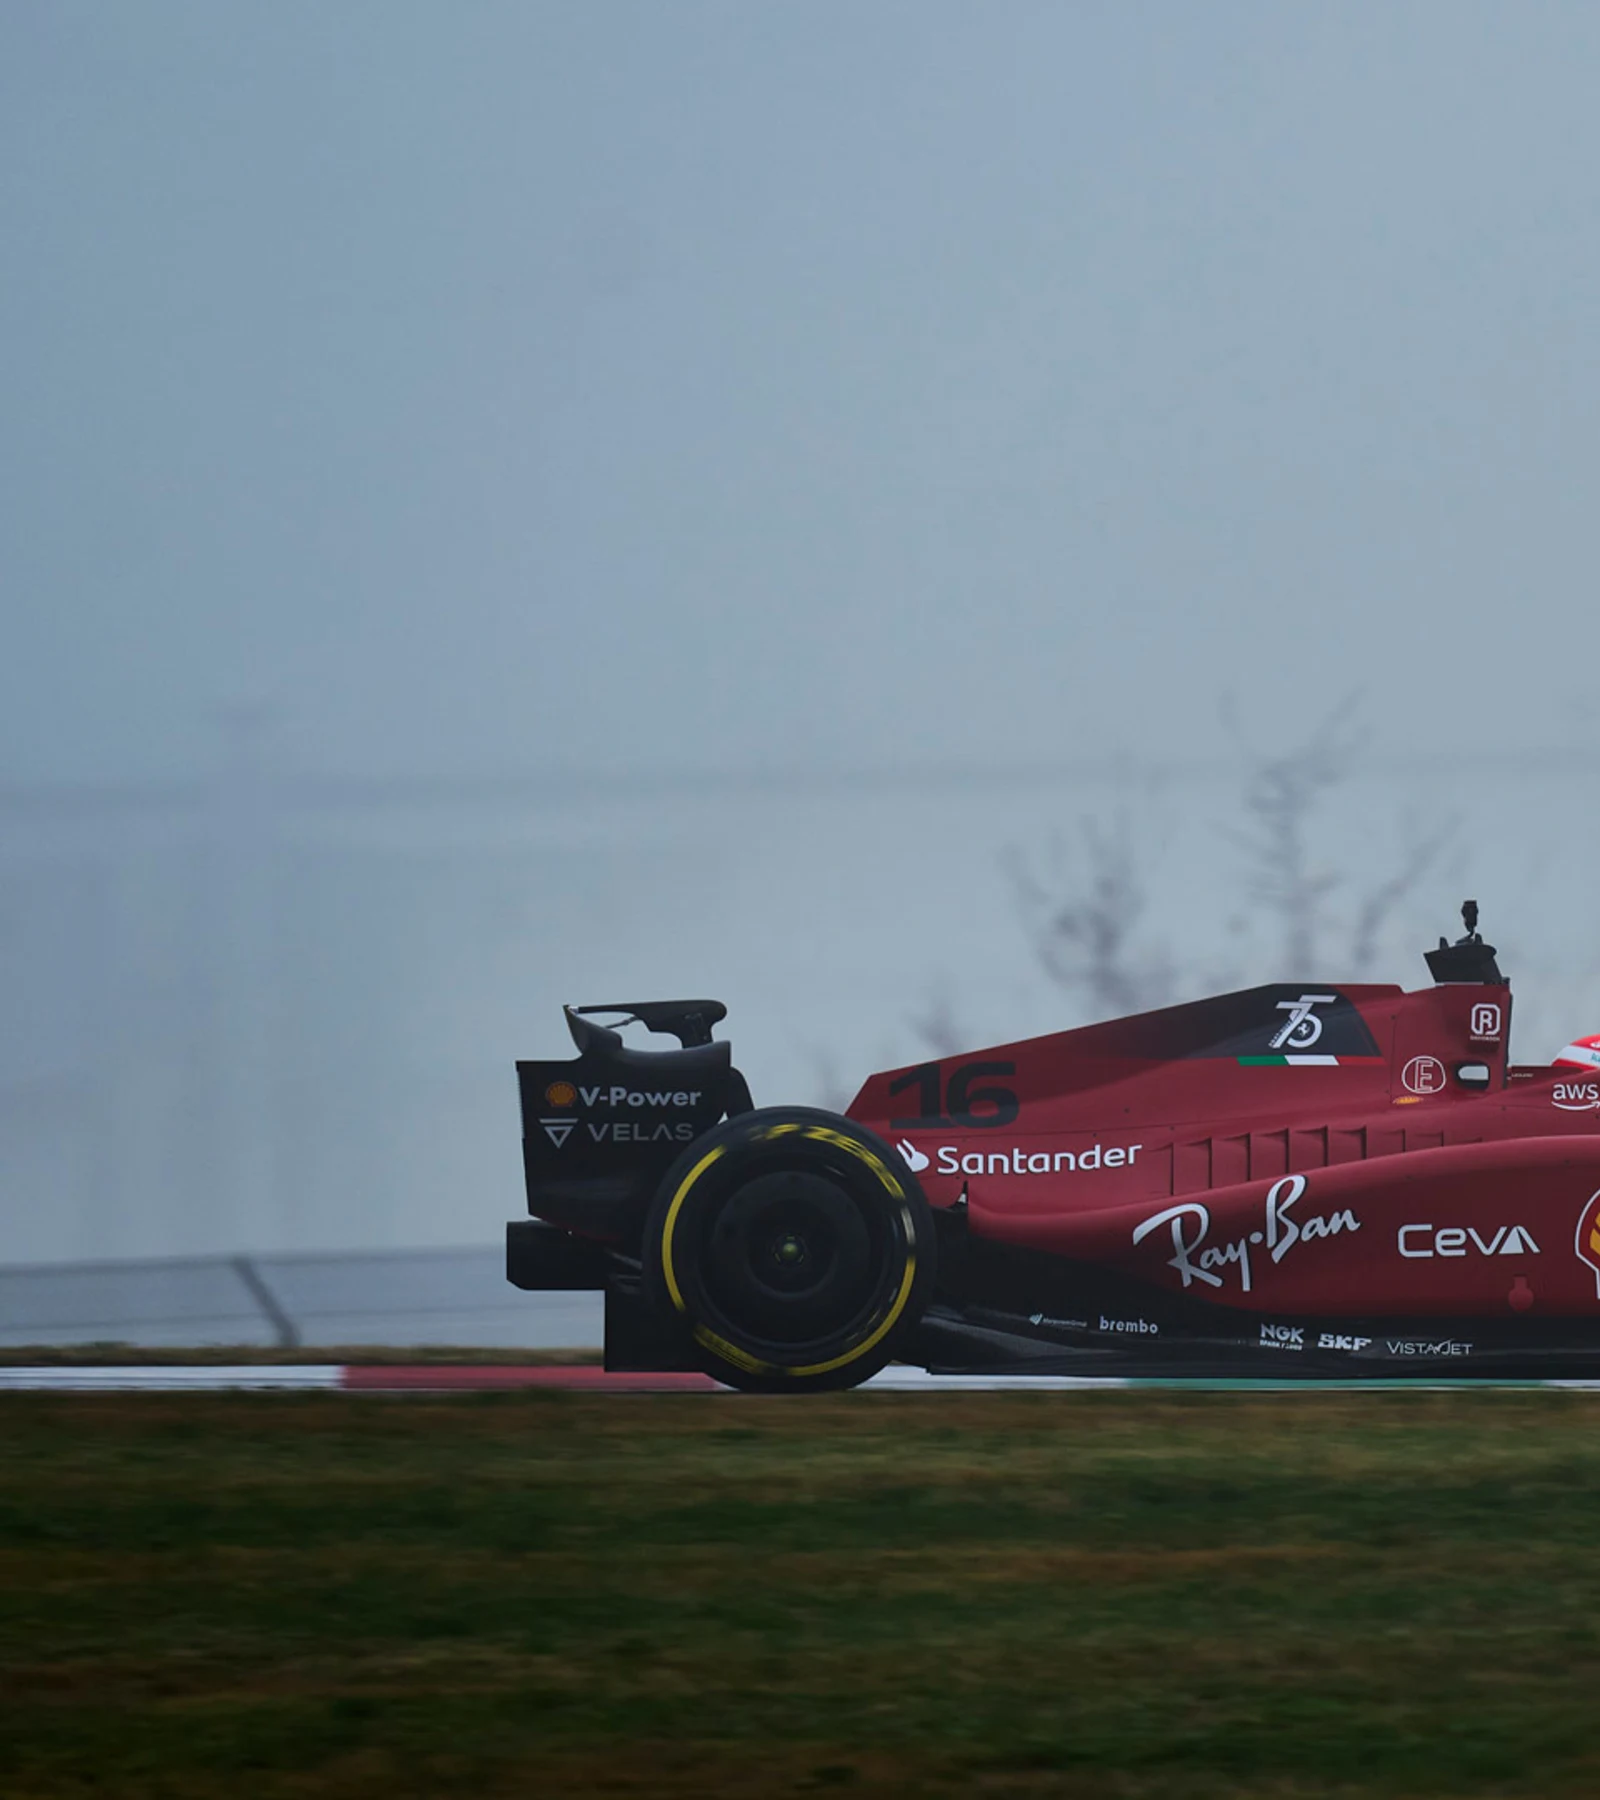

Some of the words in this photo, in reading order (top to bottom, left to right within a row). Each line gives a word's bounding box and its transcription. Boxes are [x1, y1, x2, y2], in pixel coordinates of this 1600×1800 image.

[1268, 994, 1337, 1048] 75
[578, 1086, 702, 1107] V-Power
[889, 1061, 1020, 1131] 16
[1552, 1083, 1600, 1101] aws
[587, 1122, 694, 1142] VELAS
[937, 1144, 1142, 1174] Santander
[1099, 1315, 1159, 1334] brembo
[1260, 1323, 1305, 1344] NGK
[1317, 1333, 1373, 1351] SKF
